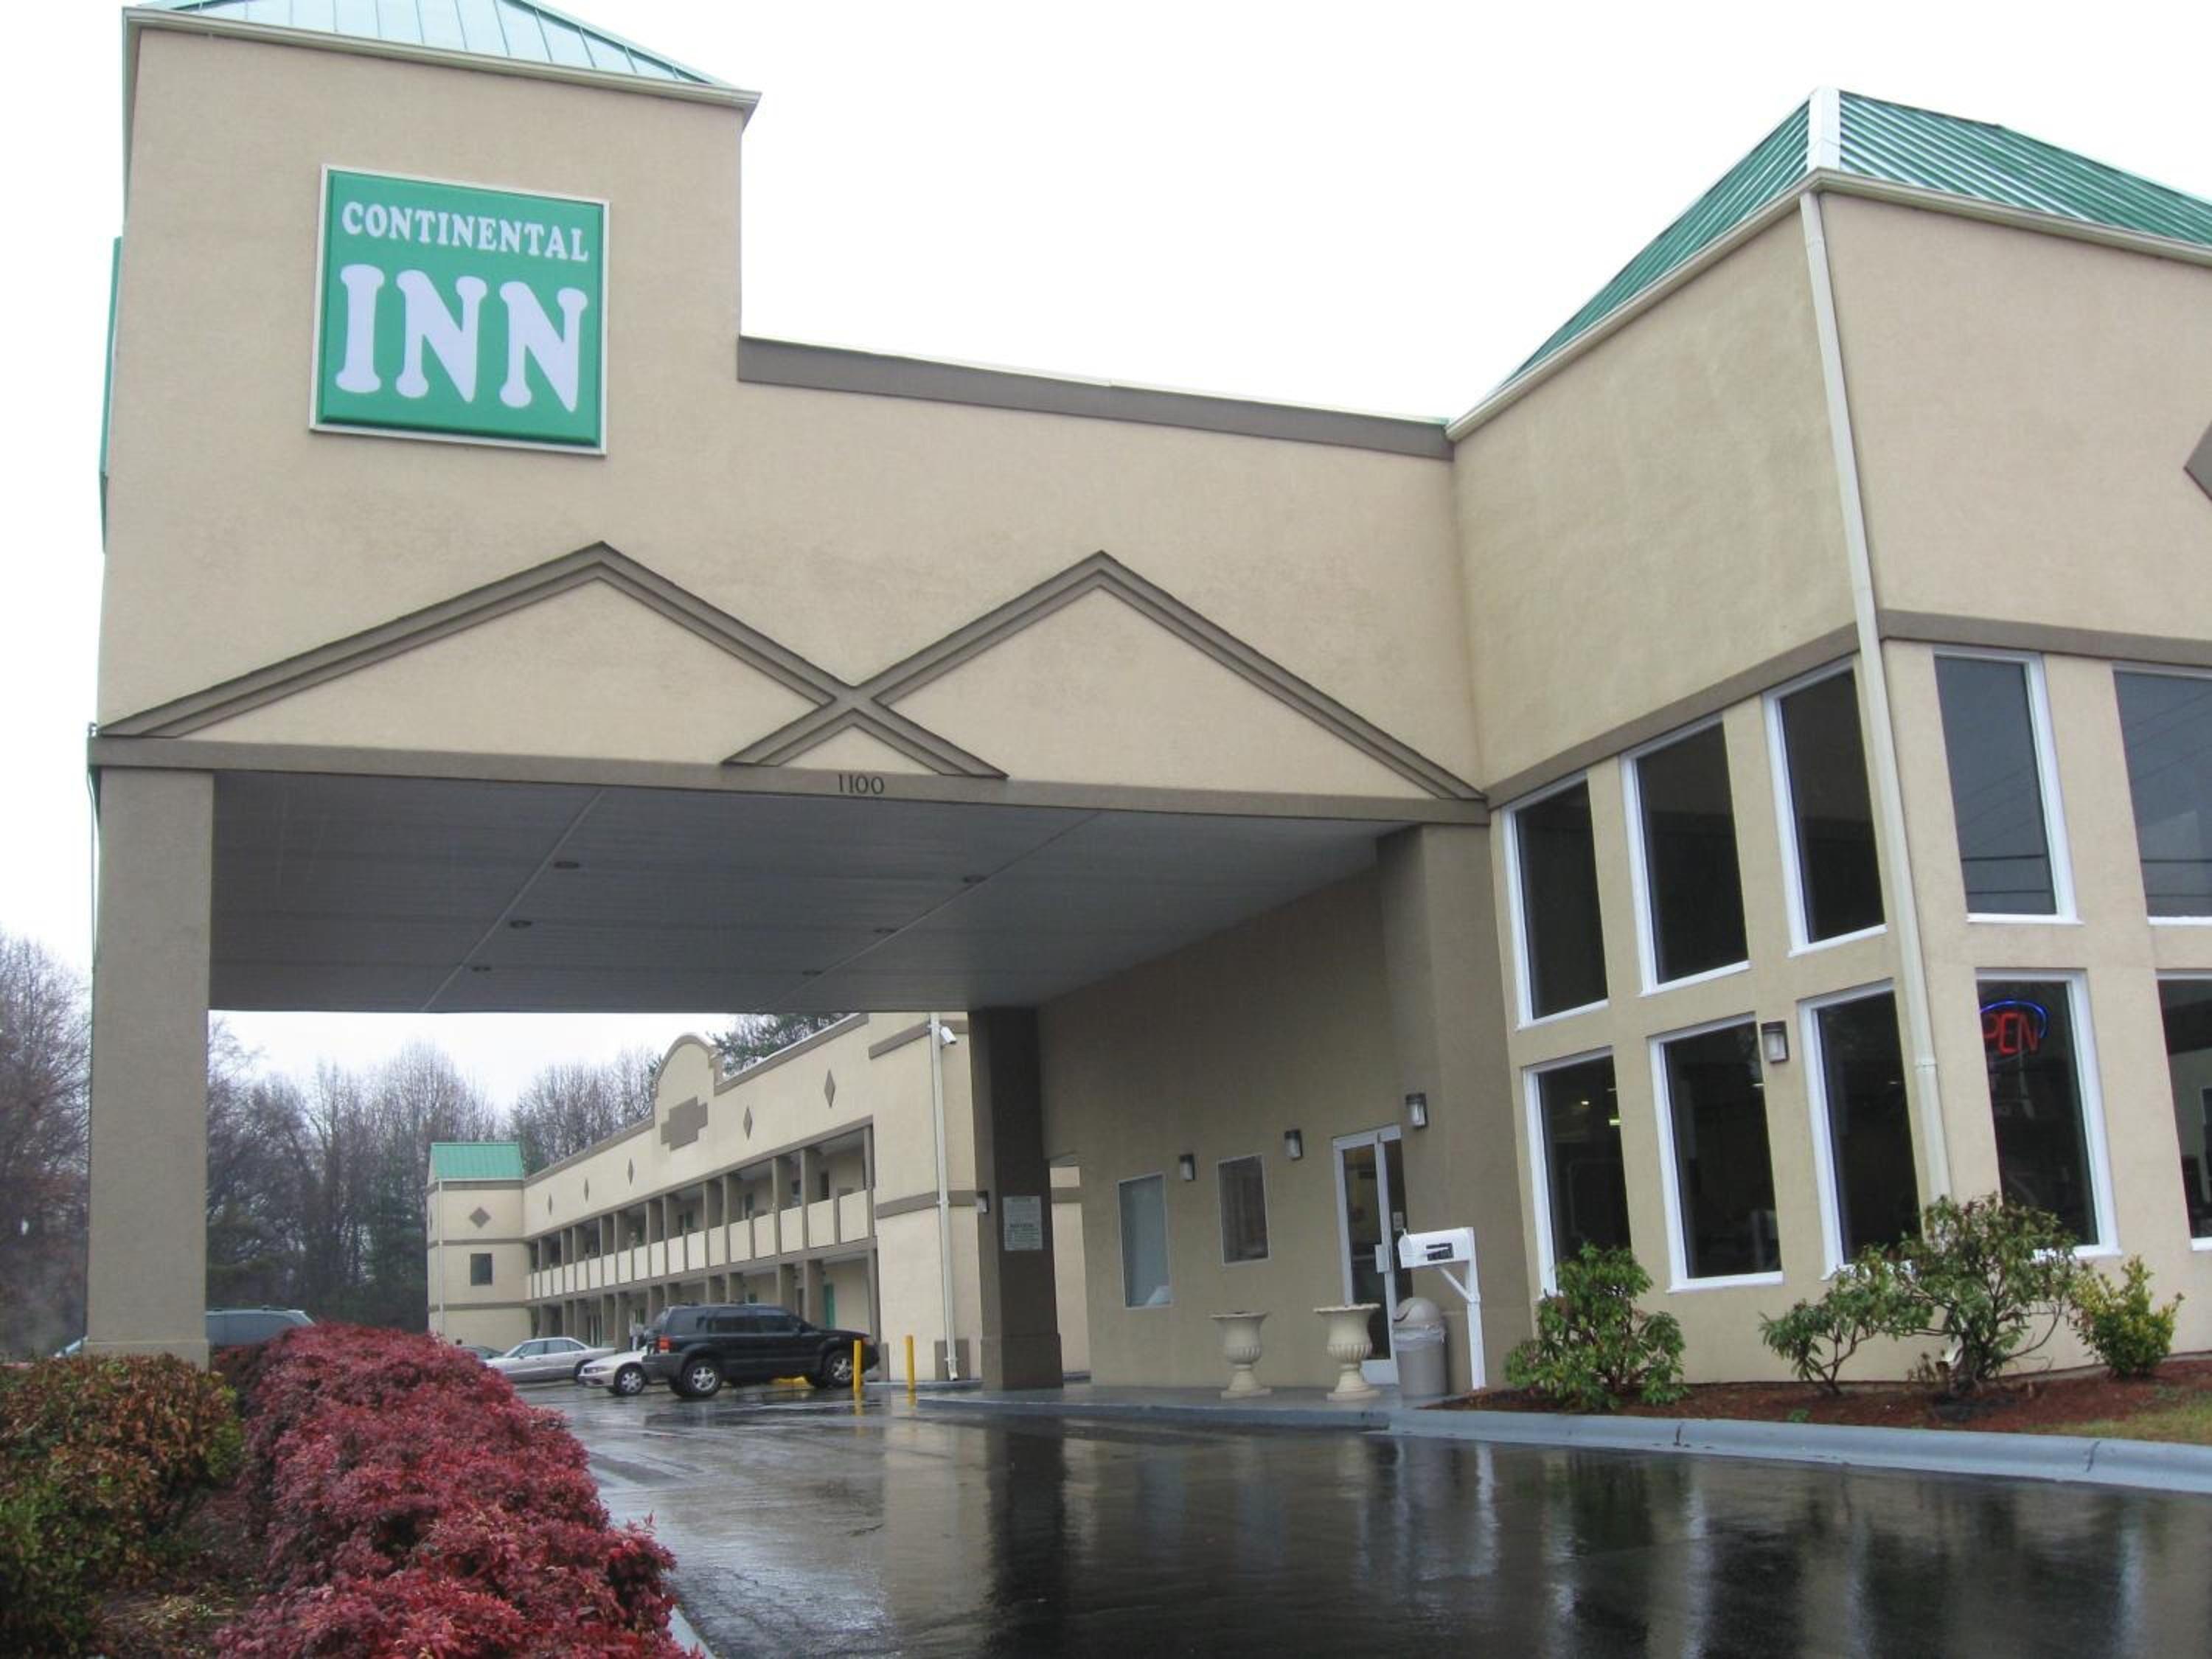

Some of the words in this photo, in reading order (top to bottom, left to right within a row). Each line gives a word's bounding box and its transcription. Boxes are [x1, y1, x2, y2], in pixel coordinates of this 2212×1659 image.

[341, 201, 589, 262] CONTINENTAL
[335, 263, 588, 413] INN
[838, 773, 885, 795] 1100
[1981, 1012, 2038, 1054] PEN
